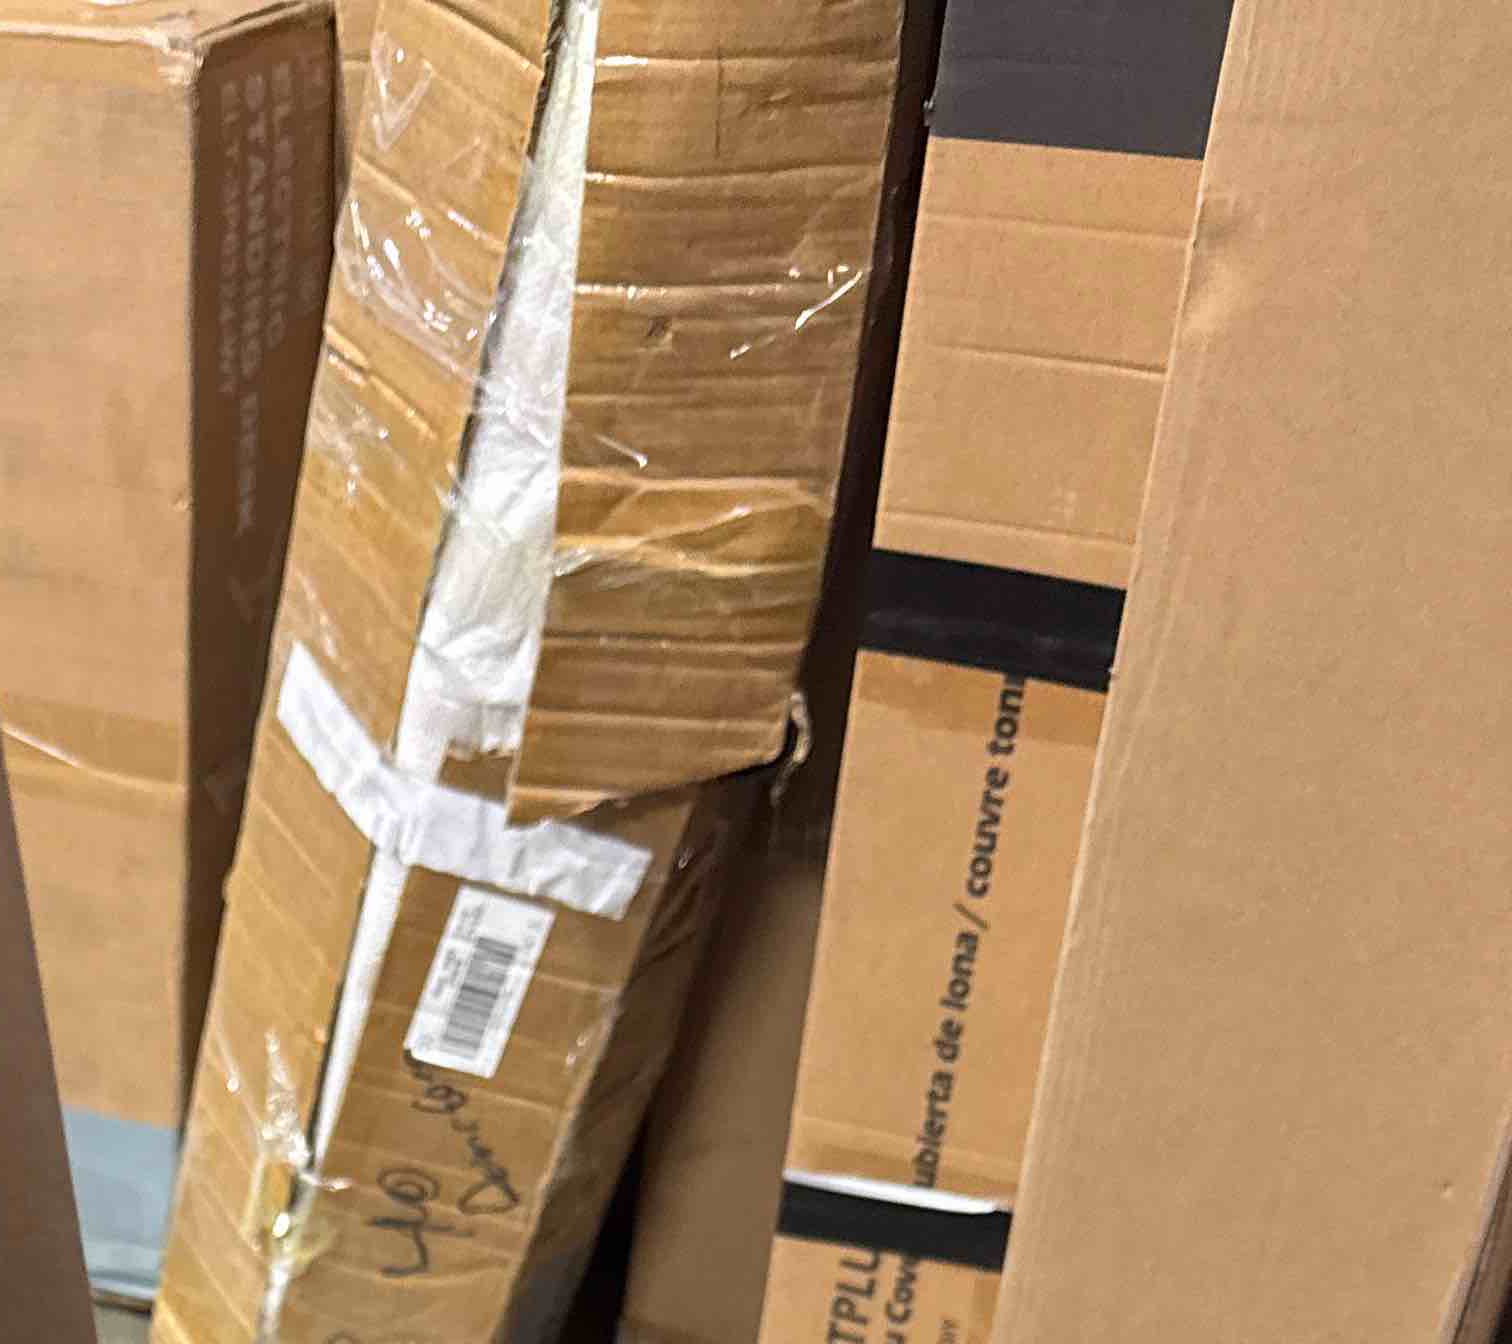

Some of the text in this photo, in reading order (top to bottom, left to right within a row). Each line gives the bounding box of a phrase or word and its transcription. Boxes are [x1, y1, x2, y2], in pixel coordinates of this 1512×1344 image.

[965, 766, 1010, 898] couvre
[938, 930, 979, 1012] lona
[934, 1017, 963, 1064] de
[911, 1070, 954, 1189] ubierta
